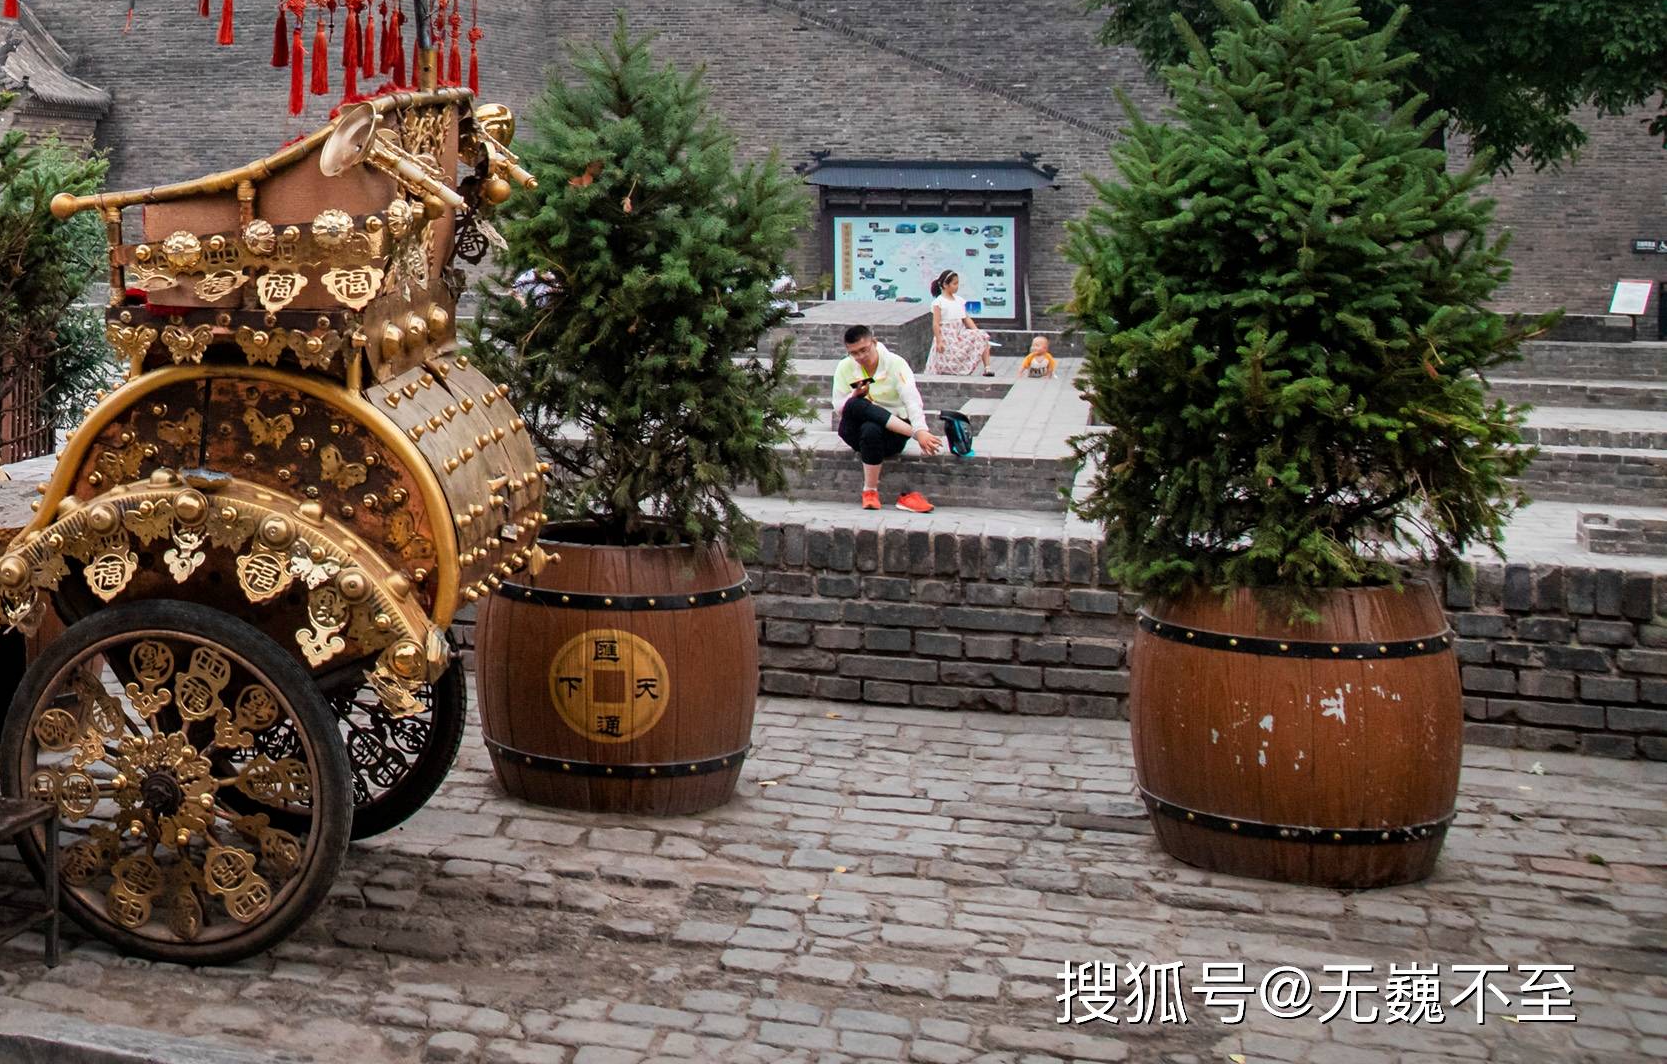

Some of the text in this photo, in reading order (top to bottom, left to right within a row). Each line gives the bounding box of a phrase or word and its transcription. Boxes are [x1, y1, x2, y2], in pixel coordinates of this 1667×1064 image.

[265, 272, 292, 300] 福
[334, 272, 369, 295] 福
[94, 562, 123, 588] 福
[245, 557, 281, 590] 福
[558, 677, 583, 698] 下
[635, 678, 659, 699] 天
[597, 716, 623, 737] 通
